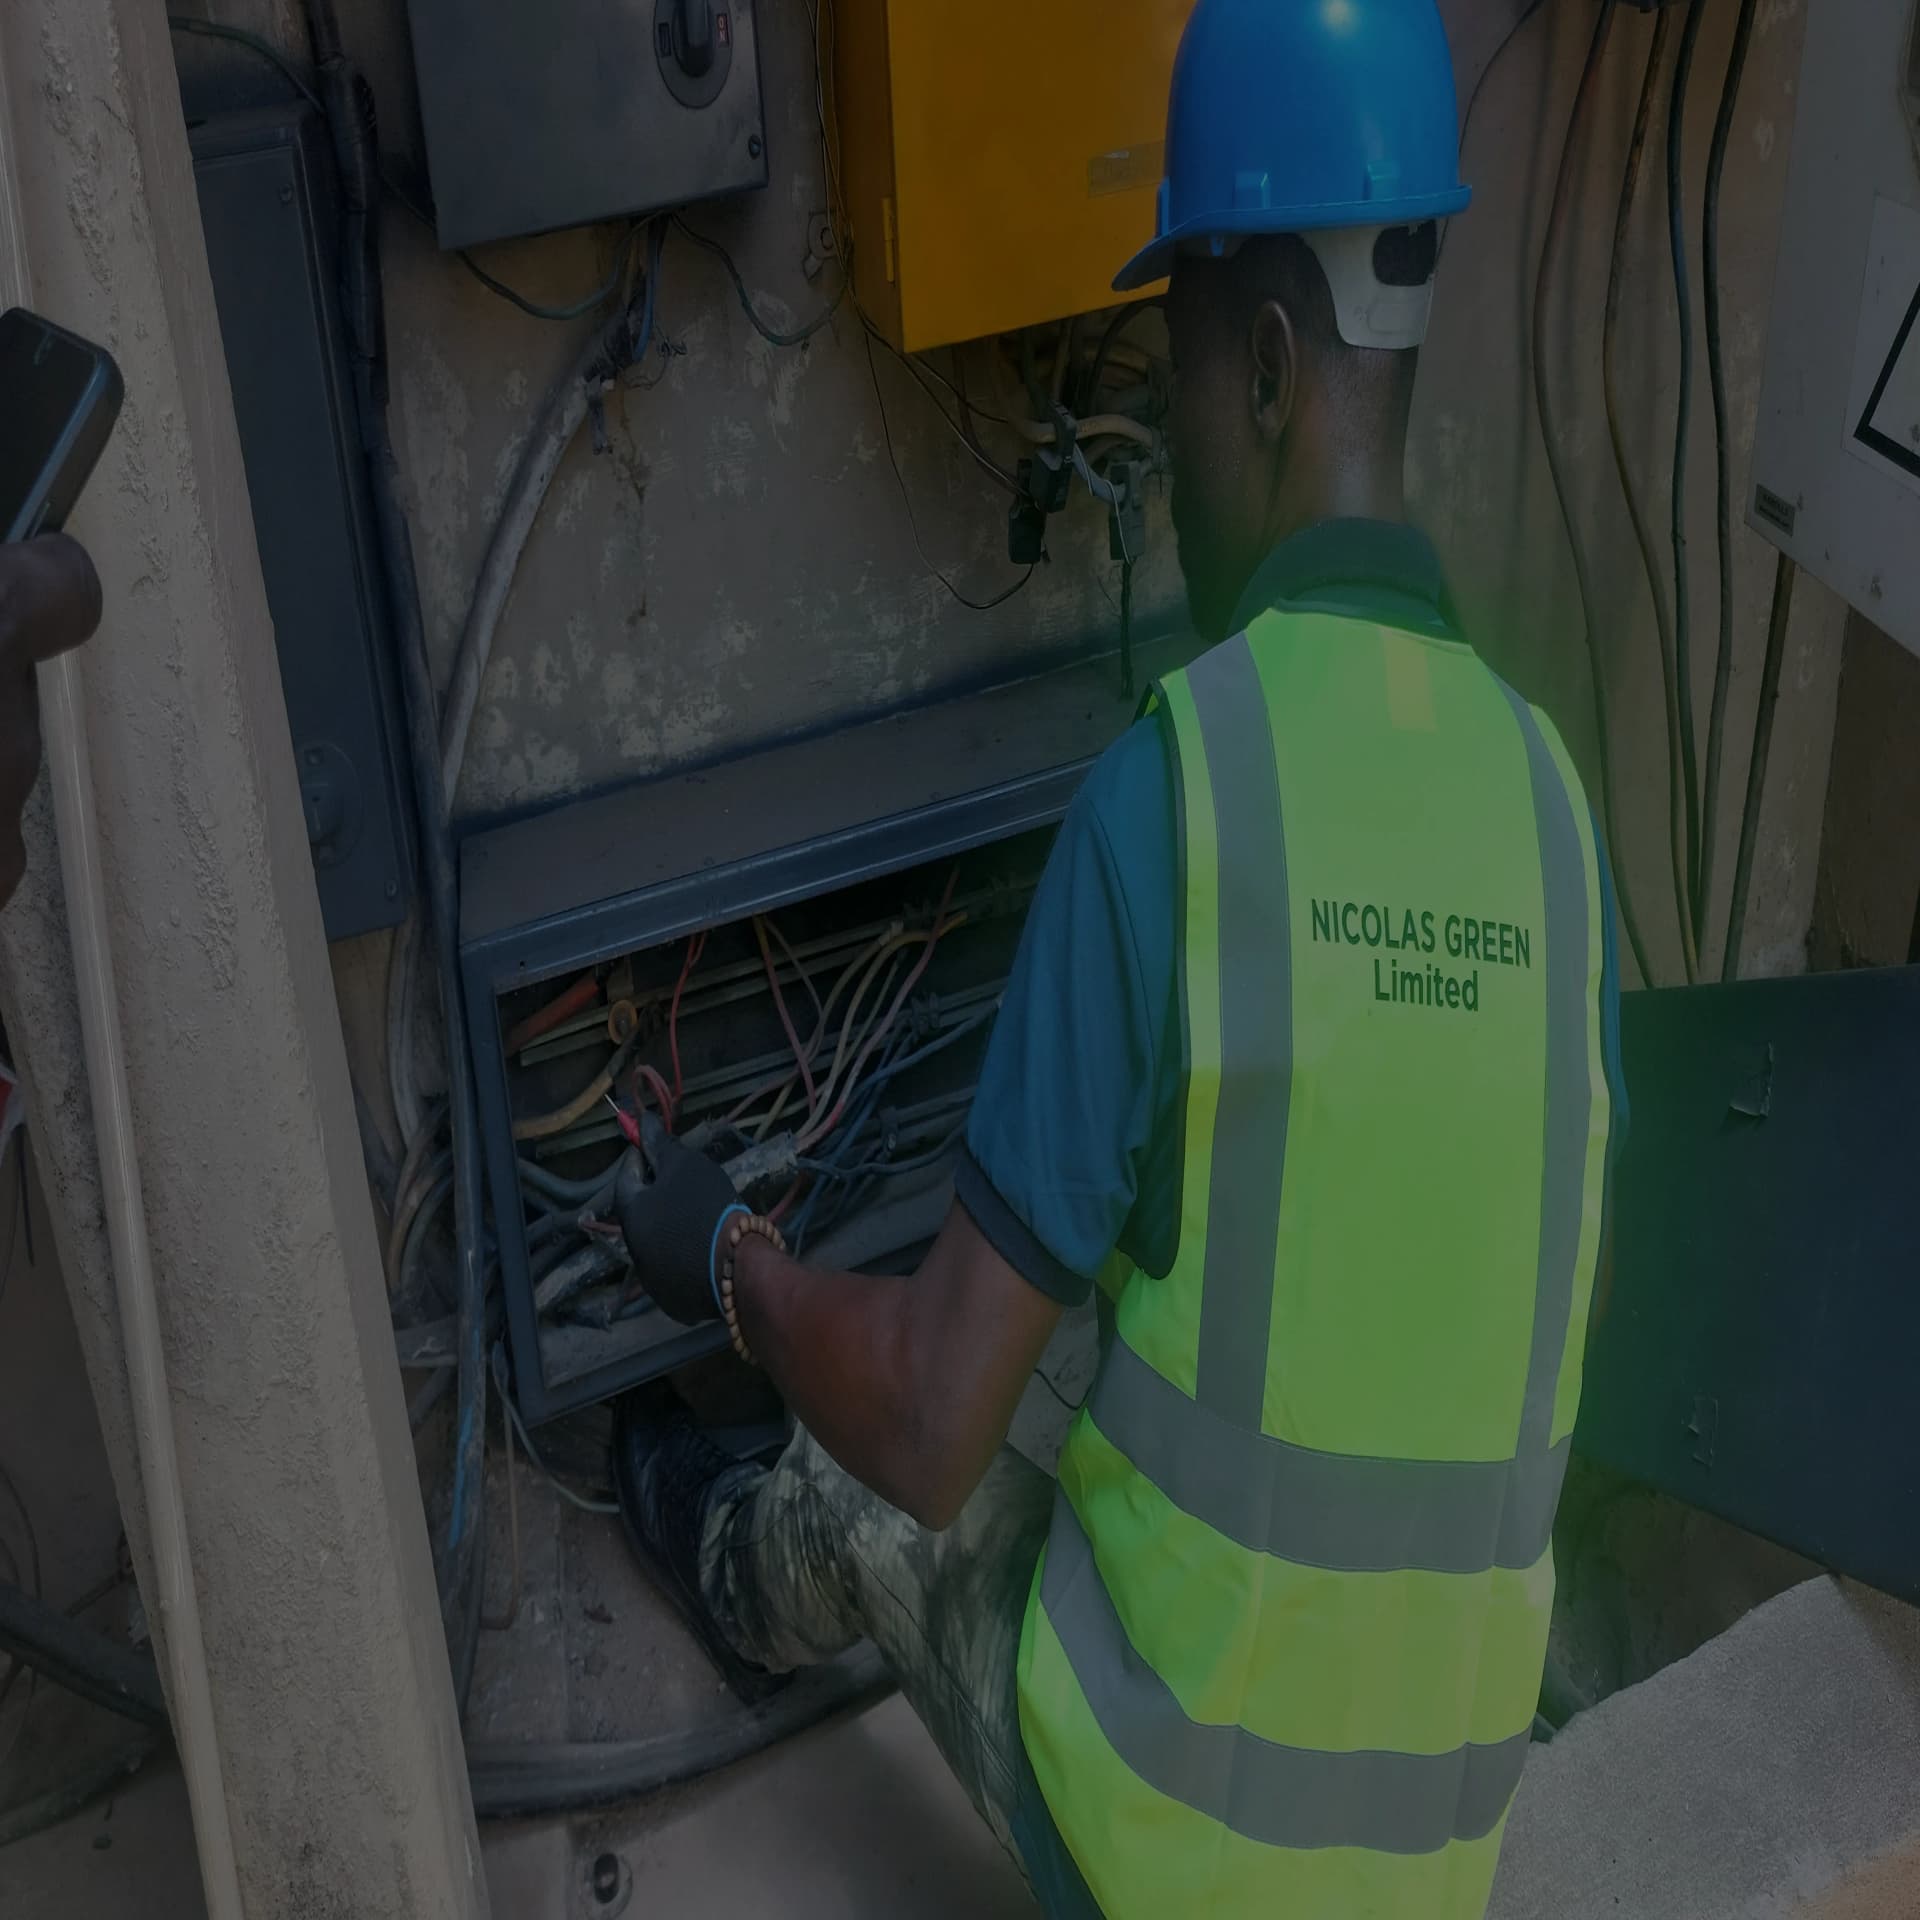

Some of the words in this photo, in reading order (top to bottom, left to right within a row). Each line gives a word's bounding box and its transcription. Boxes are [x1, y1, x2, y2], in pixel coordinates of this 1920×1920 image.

[1311, 898, 1436, 953] NICOLAS
[1445, 914, 1530, 968] GREEN
[1374, 958, 1479, 1012] Limited
